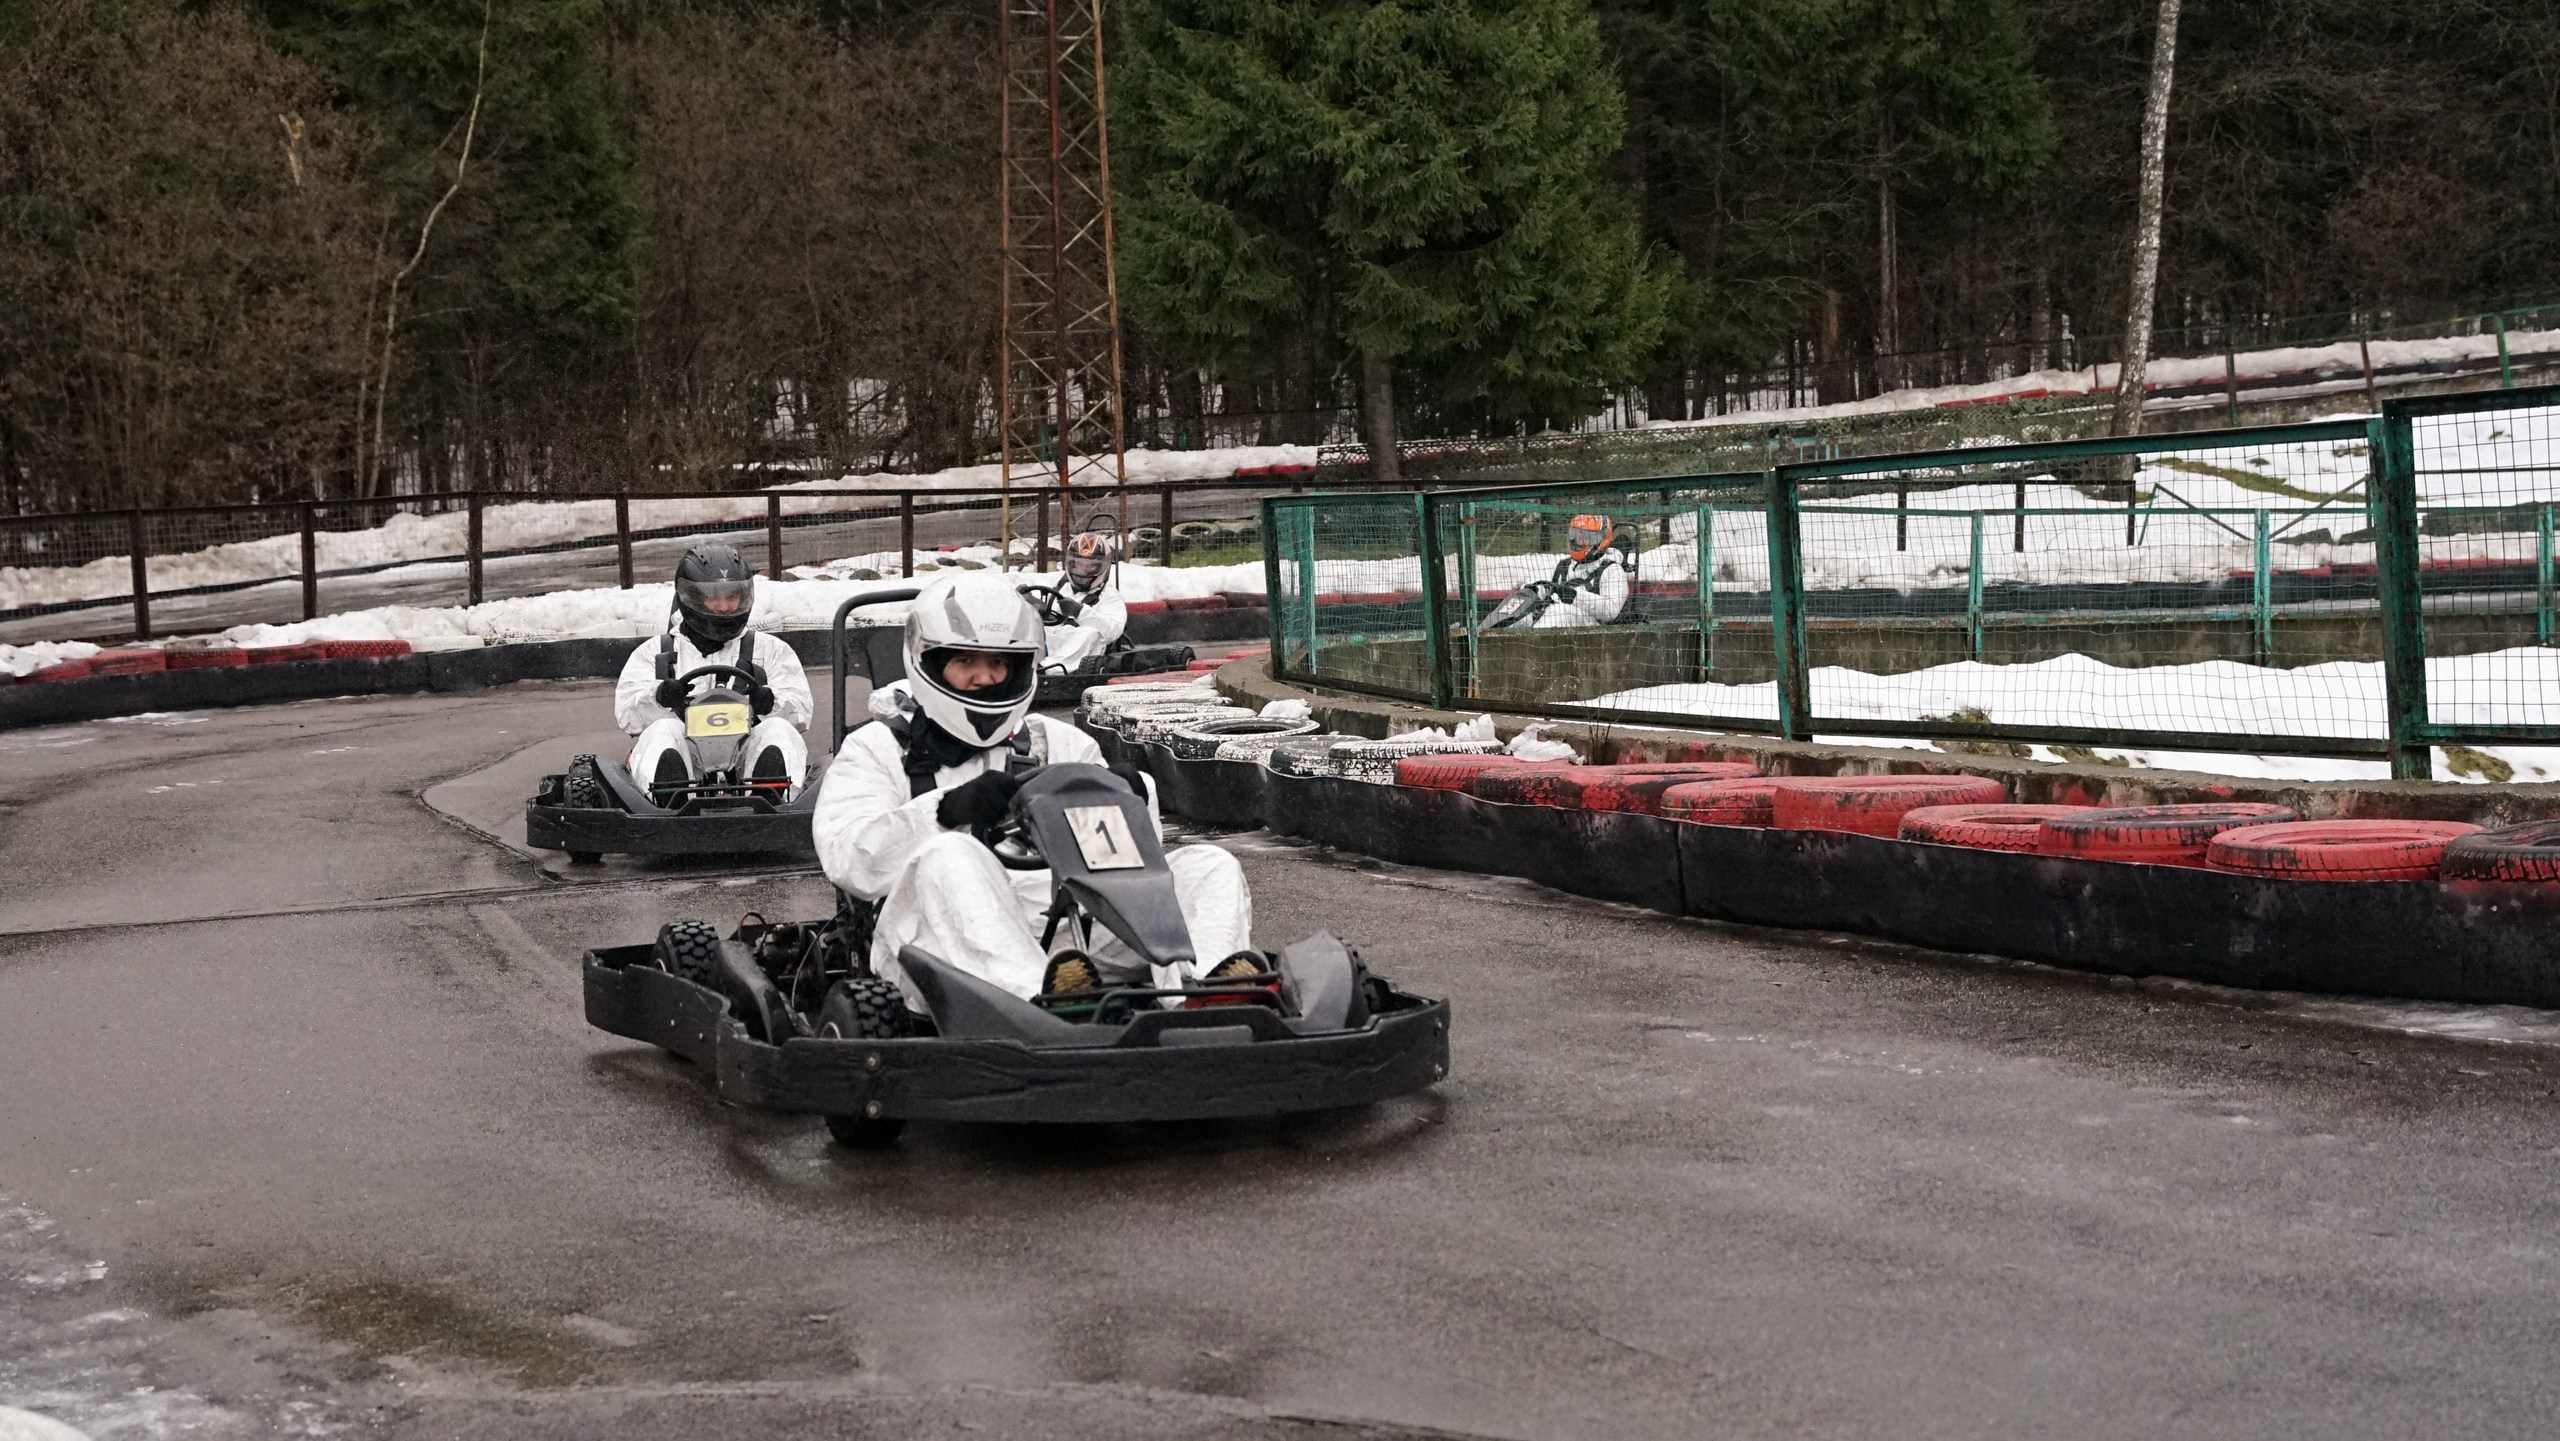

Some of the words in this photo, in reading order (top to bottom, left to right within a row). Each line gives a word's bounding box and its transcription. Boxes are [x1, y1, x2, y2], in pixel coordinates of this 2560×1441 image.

[980, 623, 1010, 632] HIZER
[706, 712, 730, 727] 6
[1095, 820, 1117, 854] 1
